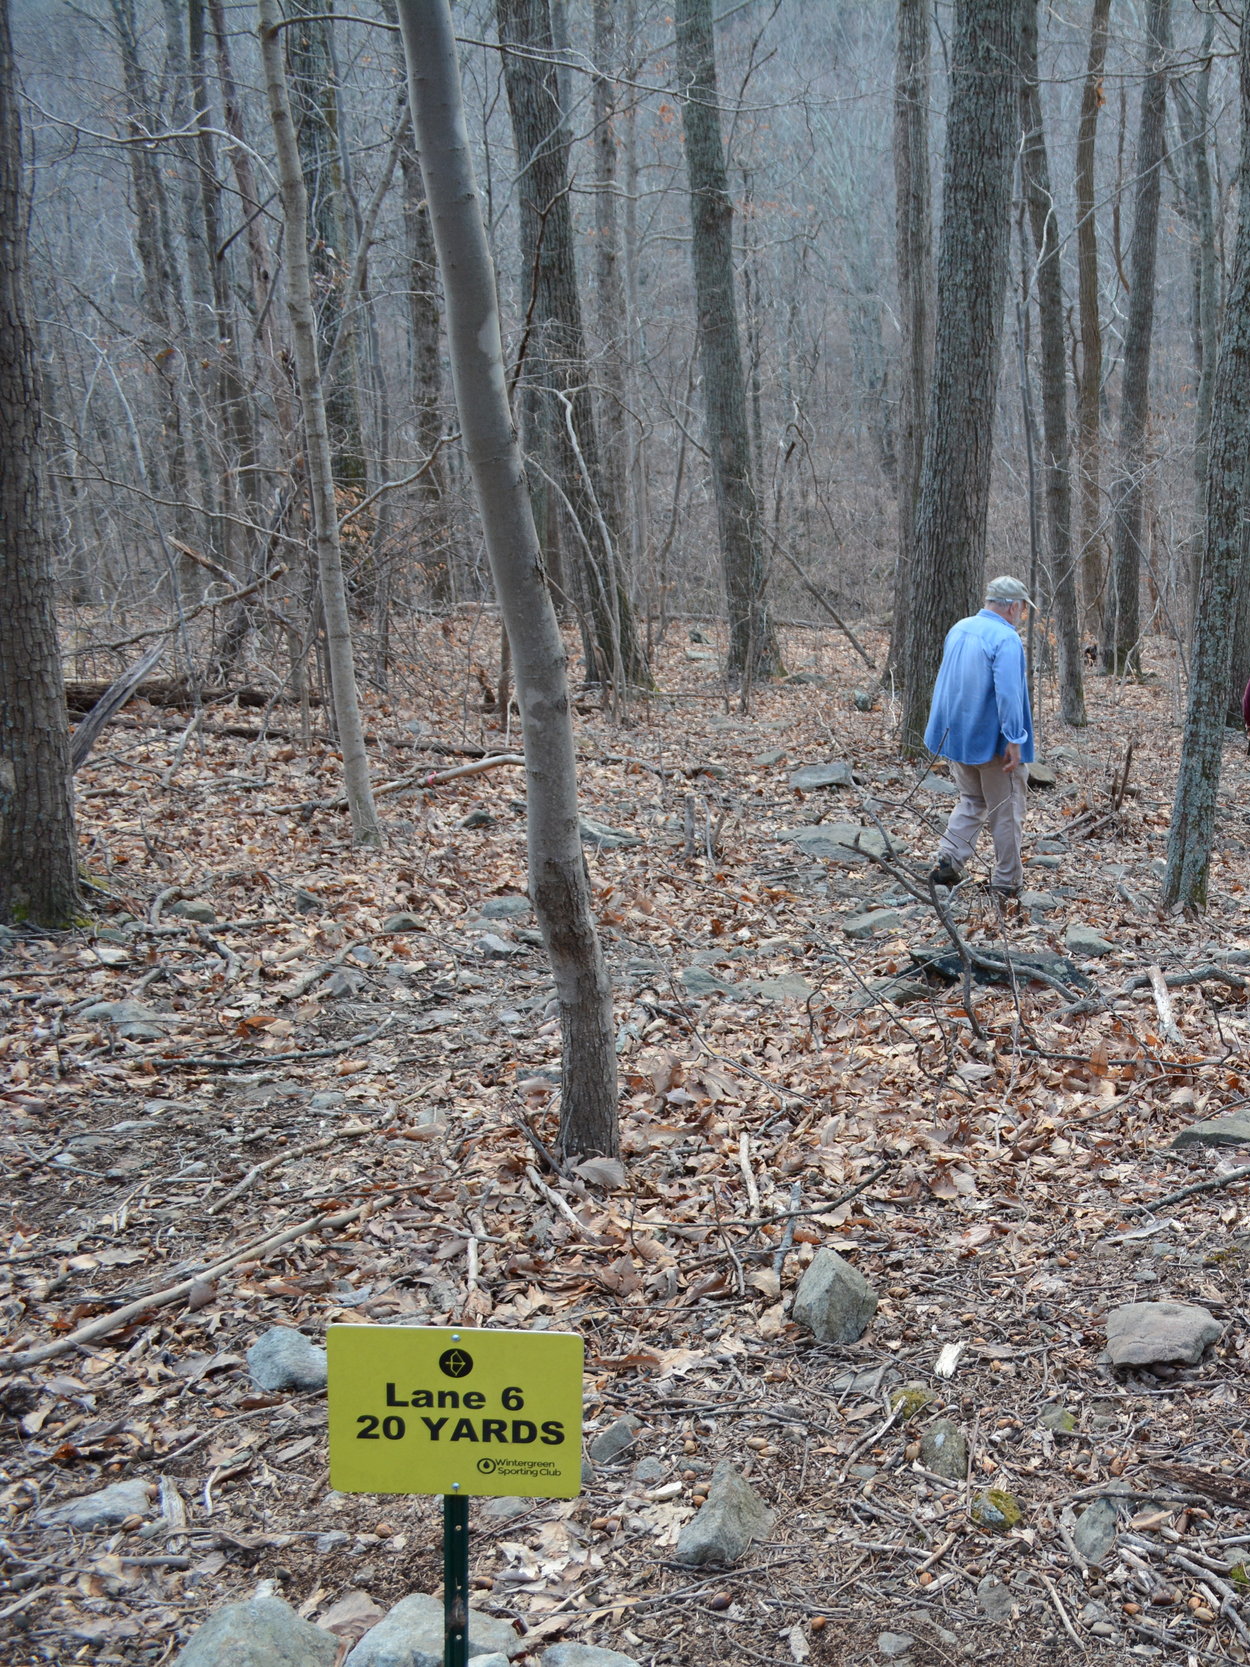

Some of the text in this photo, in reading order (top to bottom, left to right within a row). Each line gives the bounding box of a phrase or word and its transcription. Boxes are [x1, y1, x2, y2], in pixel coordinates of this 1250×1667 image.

[386, 1382, 525, 1412] Lane 6
[356, 1414, 565, 1446] 20 YARDS
[495, 1458, 555, 1468] Wintergreen
[497, 1466, 562, 1478] Sporting Club
